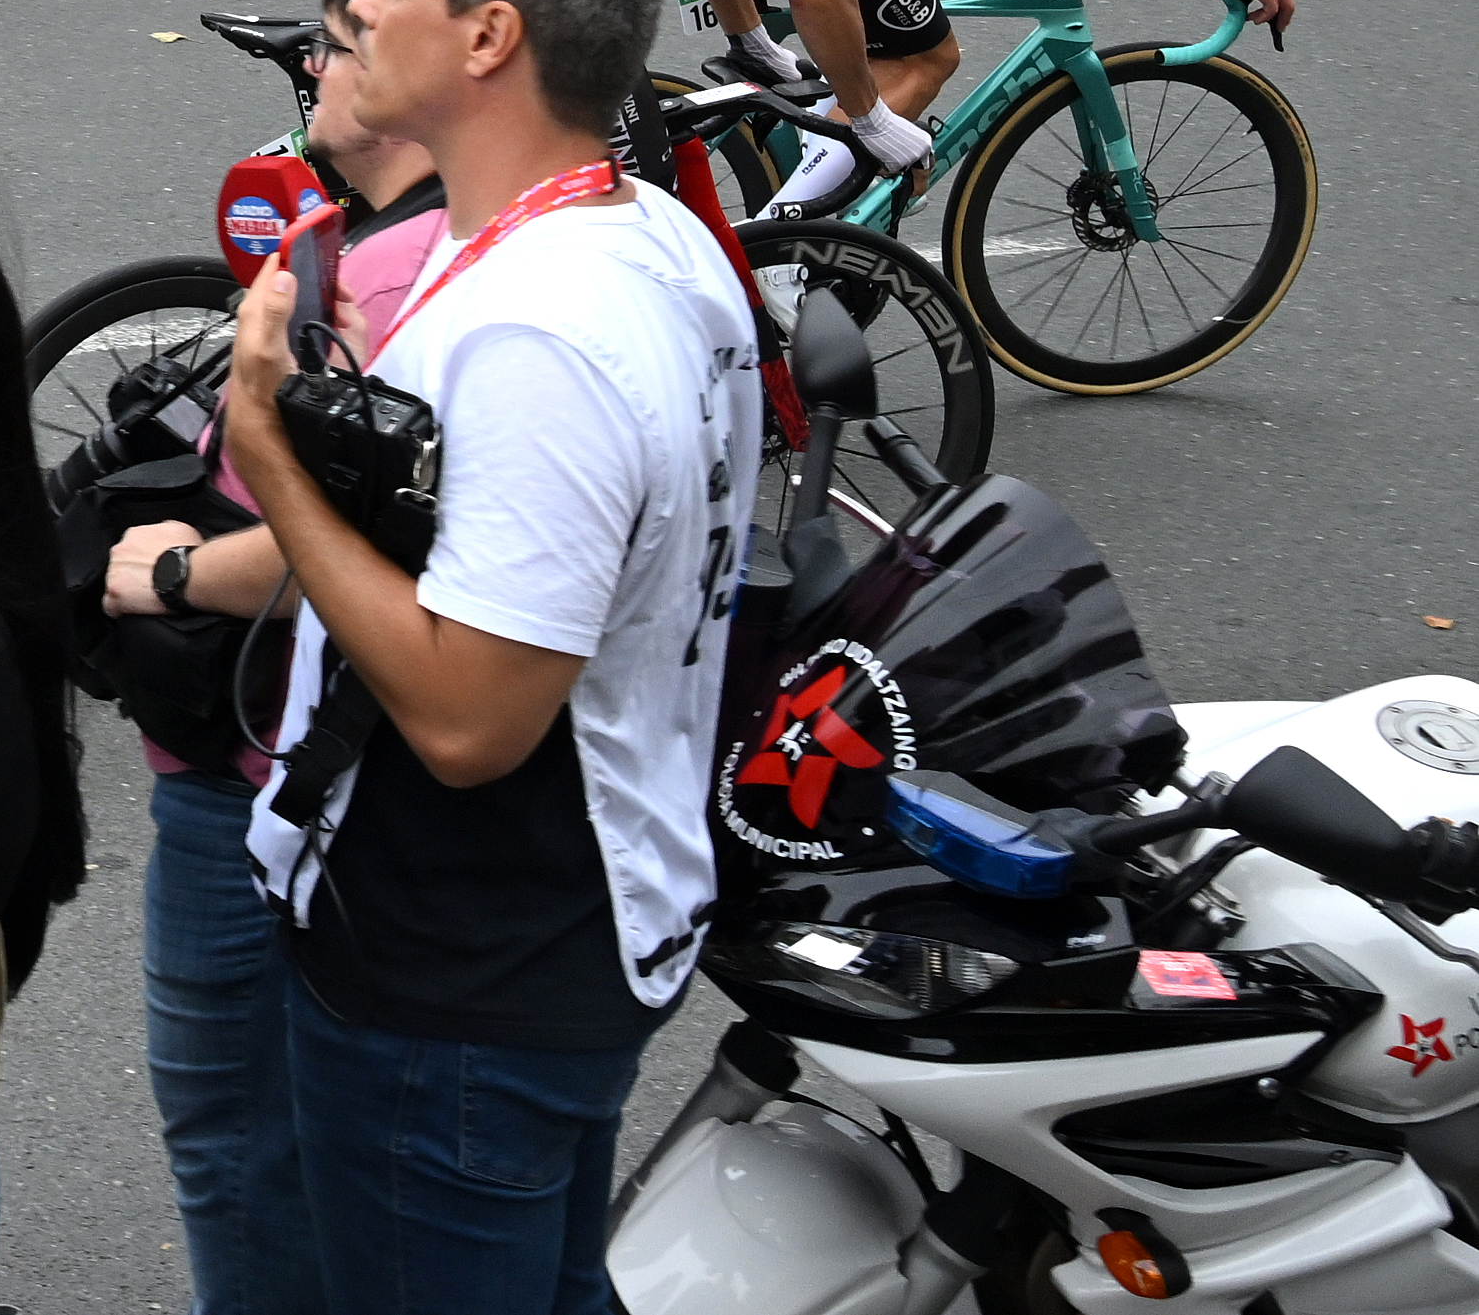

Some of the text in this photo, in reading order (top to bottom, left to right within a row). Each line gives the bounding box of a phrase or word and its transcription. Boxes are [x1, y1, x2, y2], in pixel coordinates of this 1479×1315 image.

[689, 1, 719, 32] 16
[889, 2, 911, 27] HOTELS
[622, 94, 641, 125] VINI
[794, 239, 974, 375] NEWMEN
[724, 809, 845, 860] MUNICIPAL
